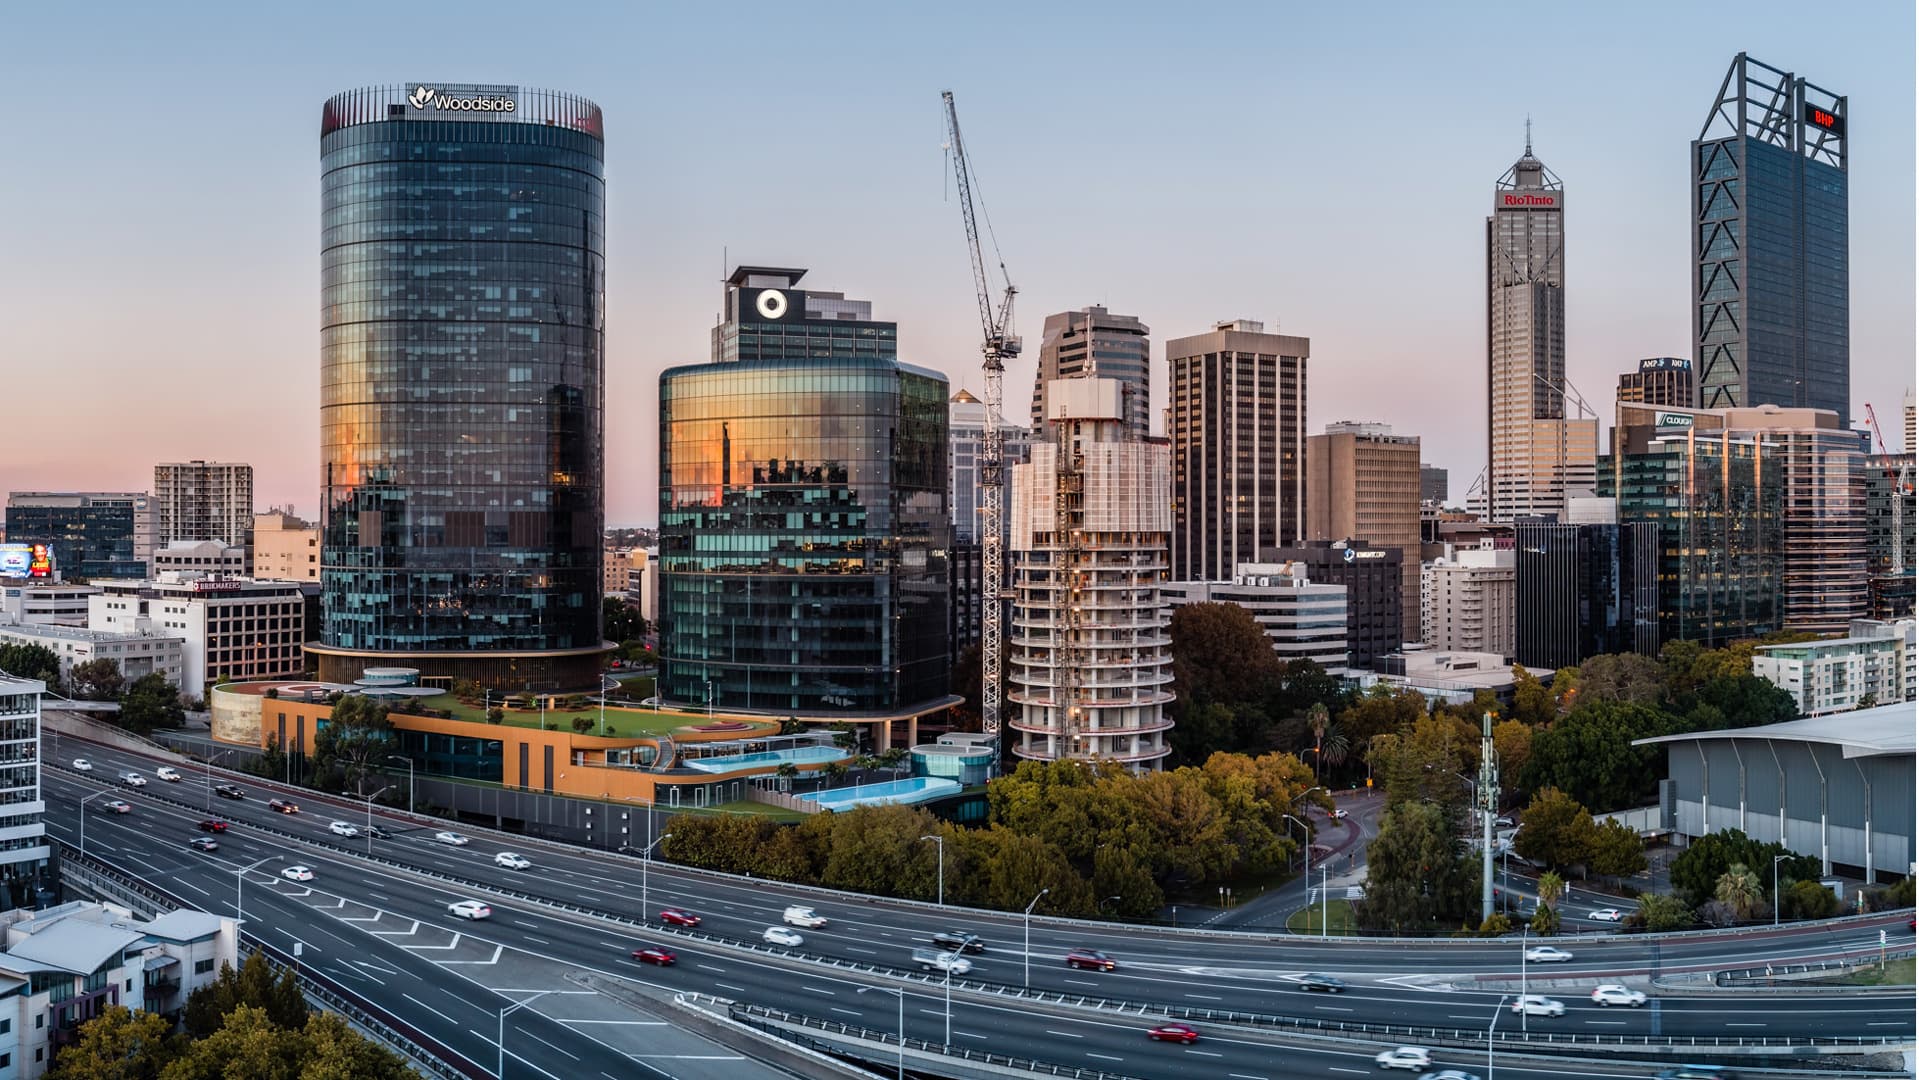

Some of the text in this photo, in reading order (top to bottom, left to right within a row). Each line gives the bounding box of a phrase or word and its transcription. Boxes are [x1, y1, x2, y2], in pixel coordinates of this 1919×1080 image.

[434, 96, 515, 112] Woodside
[1815, 110, 1834, 128] BHP
[1666, 416, 1693, 425] CLOUGH
